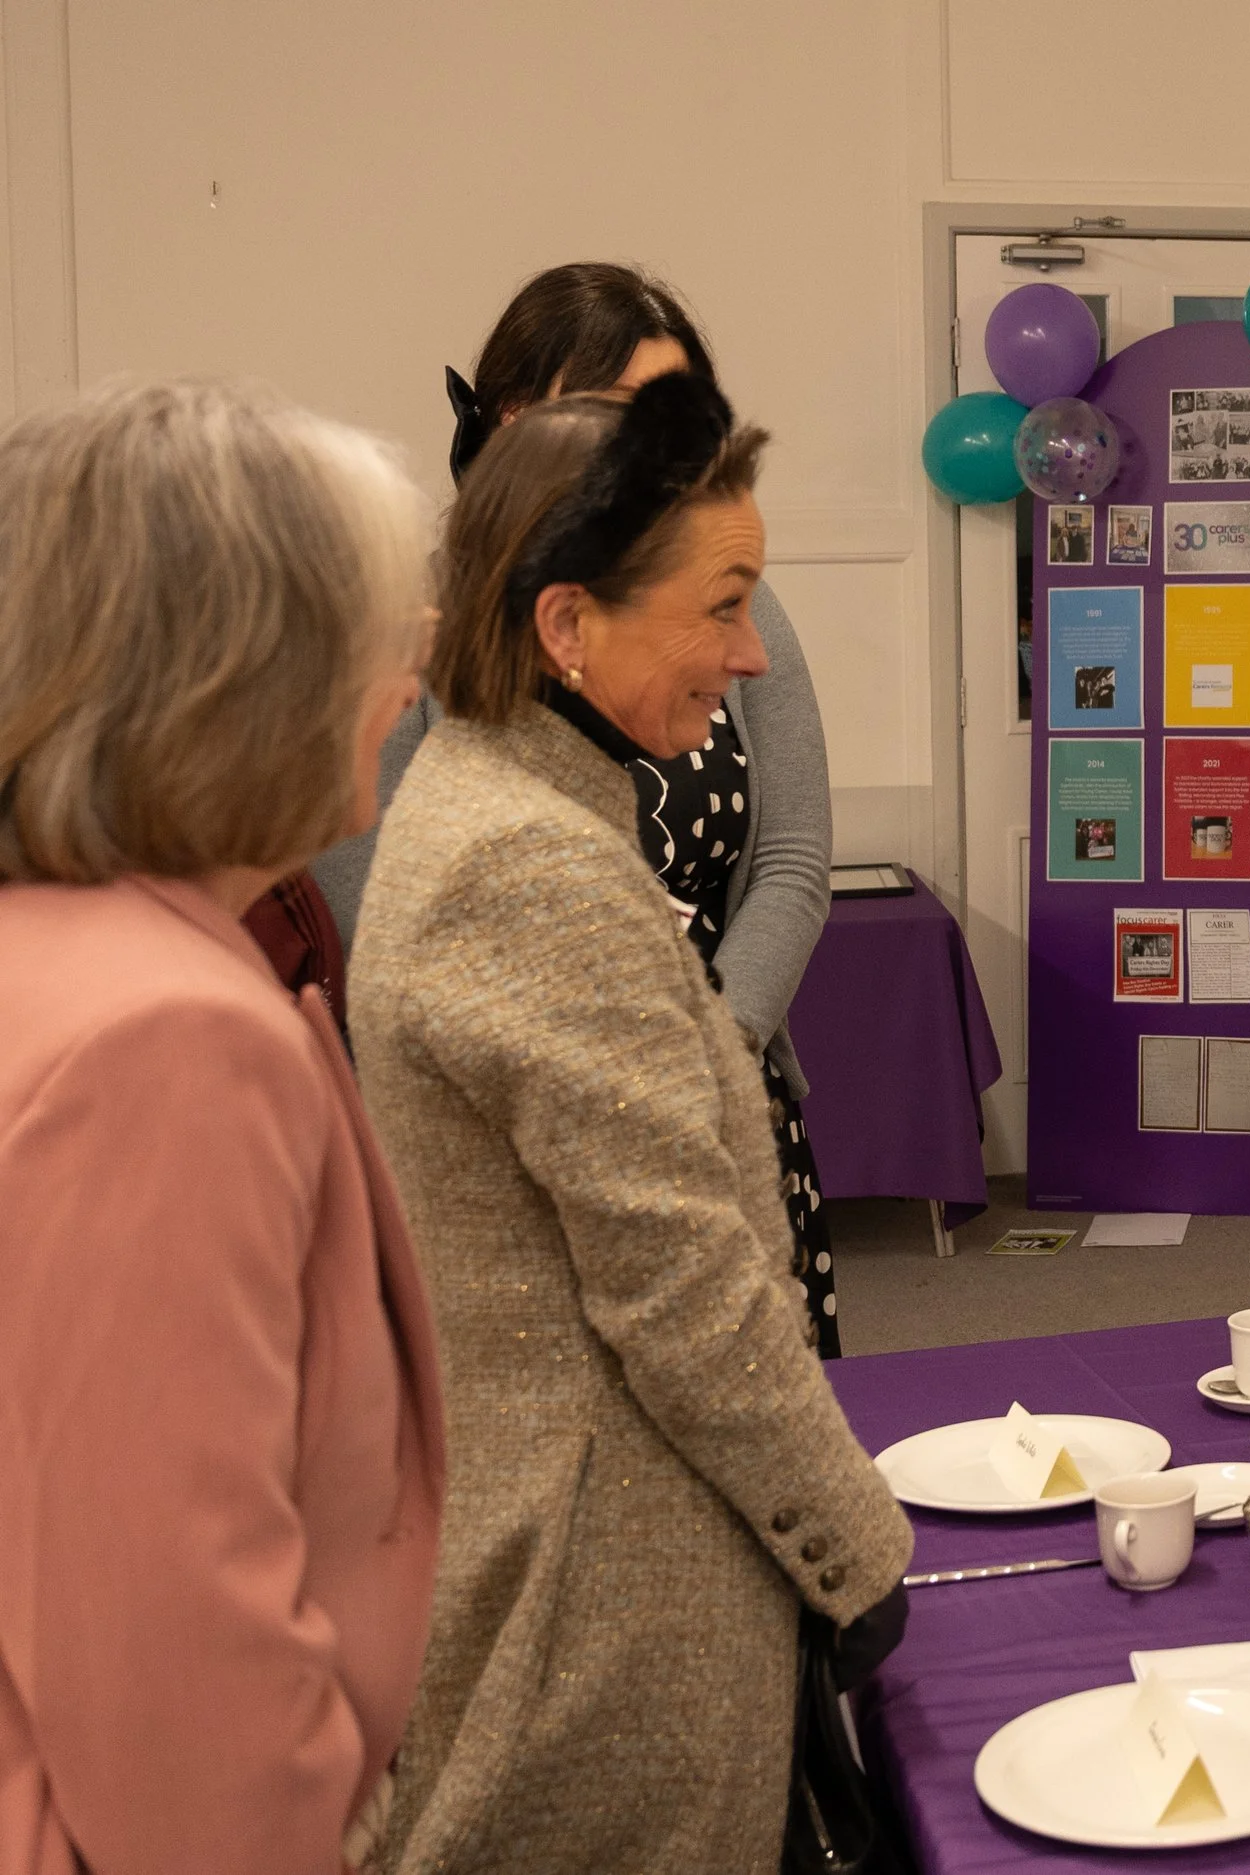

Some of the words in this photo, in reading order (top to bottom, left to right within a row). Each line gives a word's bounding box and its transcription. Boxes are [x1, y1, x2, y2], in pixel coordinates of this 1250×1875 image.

[1174, 523, 1208, 551] 30
[1218, 533, 1246, 546] plus
[1086, 609, 1103, 617] 1991
[1087, 759, 1105, 768] 2014
[1202, 759, 1221, 768] 2021
[1205, 921, 1235, 929] CARER
